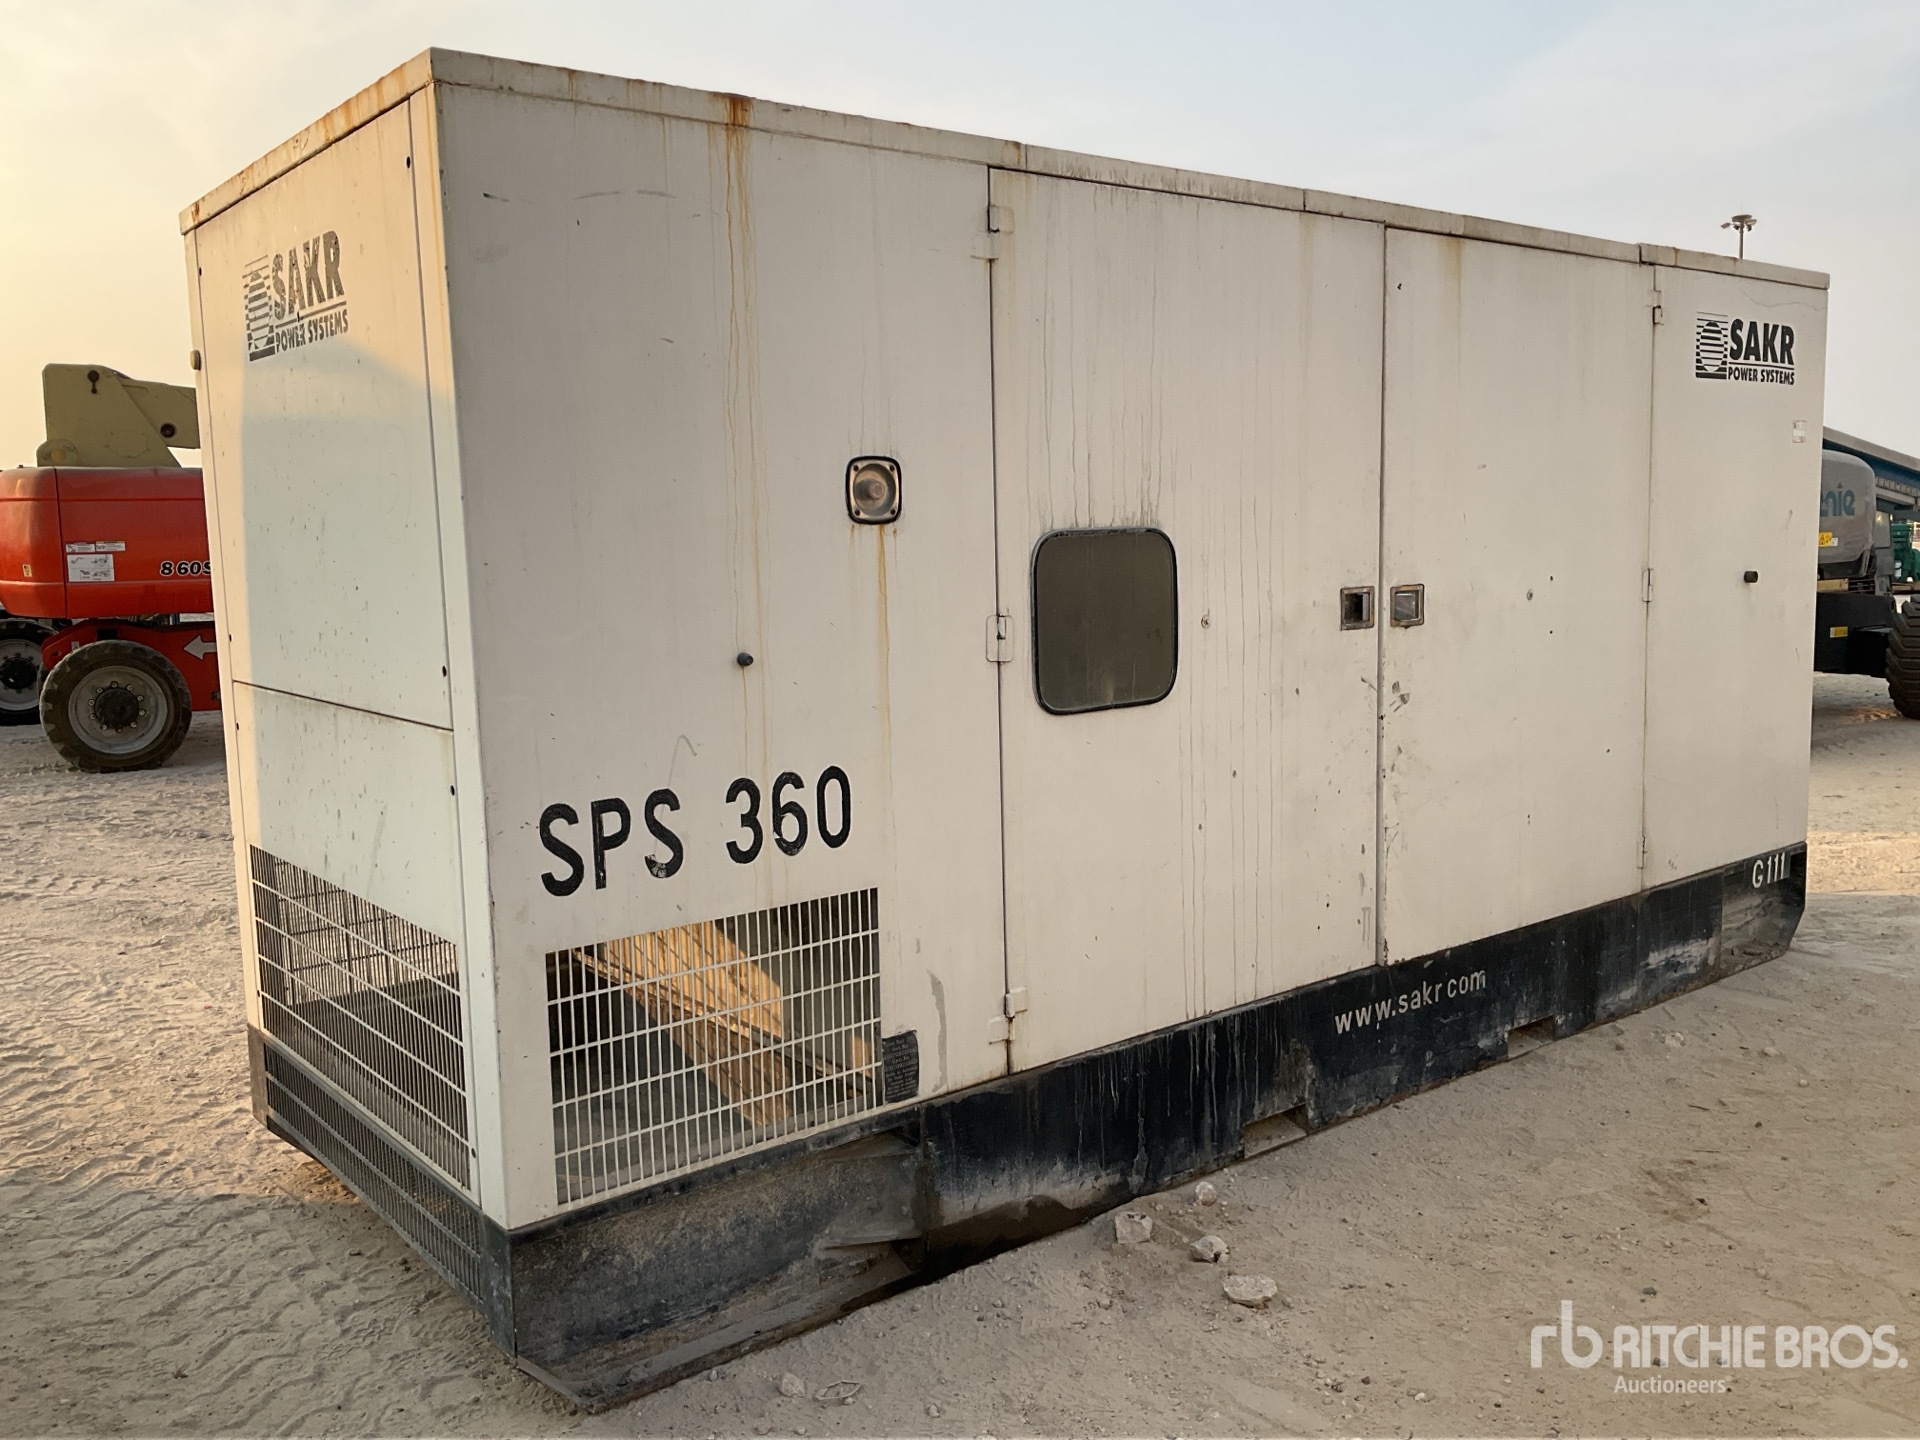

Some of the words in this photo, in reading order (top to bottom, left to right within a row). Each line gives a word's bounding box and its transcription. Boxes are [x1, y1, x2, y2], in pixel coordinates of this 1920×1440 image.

[271, 230, 345, 321] SAKR
[275, 323, 306, 353] POWER
[308, 309, 349, 343] SYSTEMS
[1729, 318, 1795, 366] SAKR
[1728, 366, 1759, 382] POWER
[1760, 368, 1795, 386] SYSTEMS
[539, 788, 684, 897] SPS
[726, 765, 851, 864] 360
[1752, 852, 1786, 889] G111
[1334, 969, 1487, 1035] www.sakrcom
